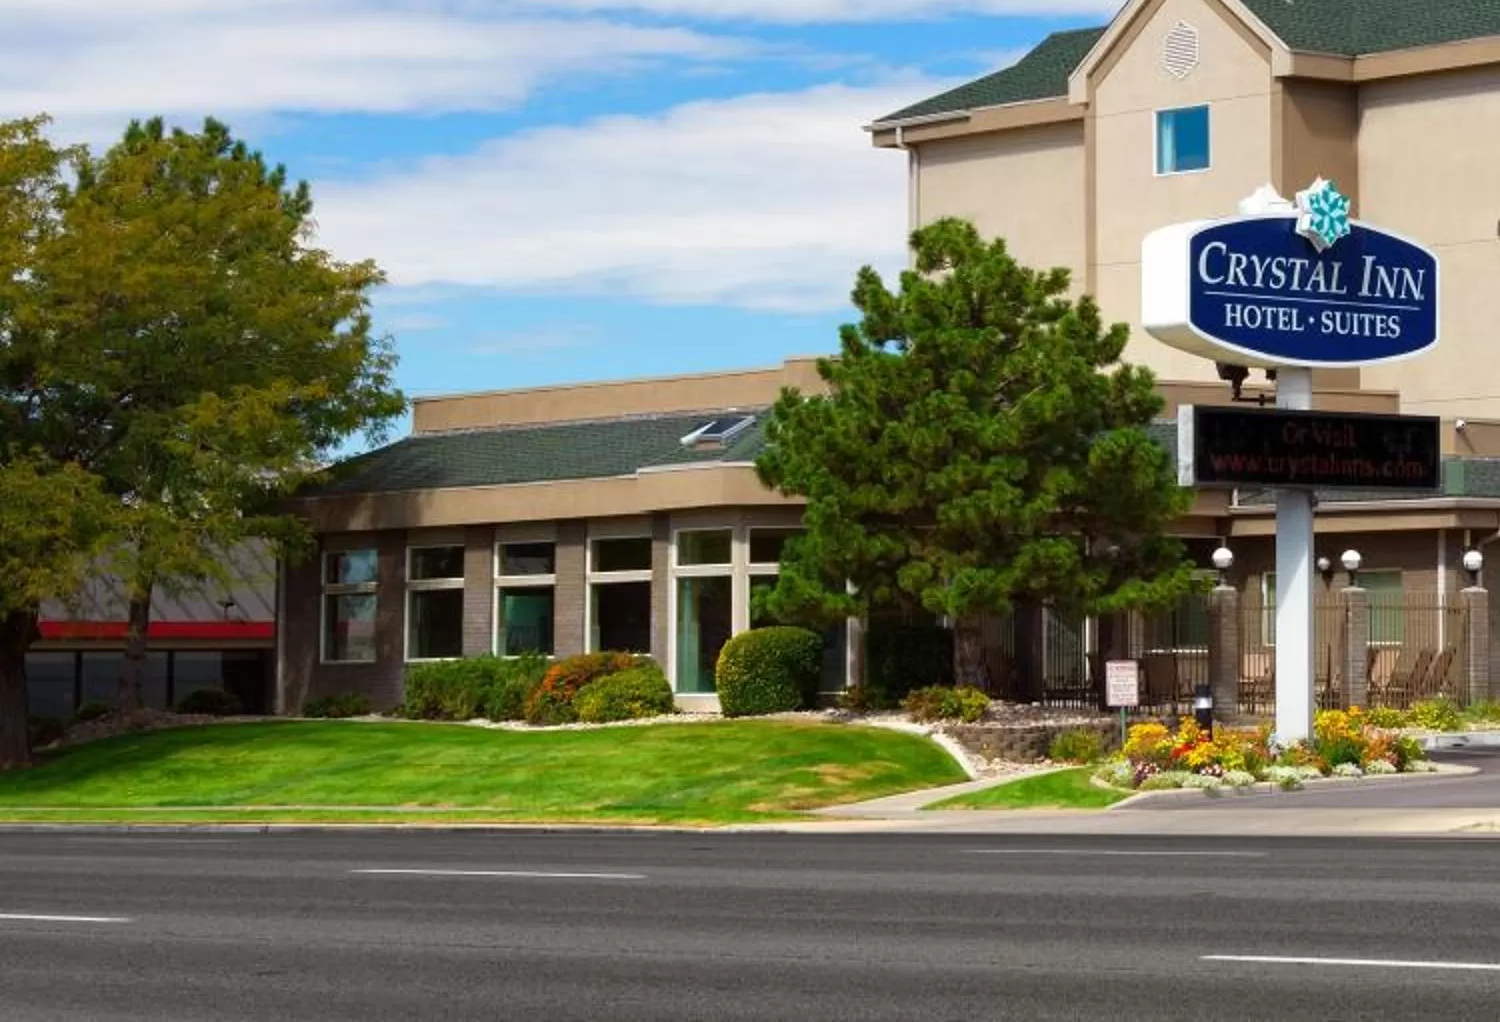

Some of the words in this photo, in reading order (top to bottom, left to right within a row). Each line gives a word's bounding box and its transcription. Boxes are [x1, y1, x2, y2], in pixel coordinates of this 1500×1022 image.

[1198, 241, 1347, 294] CRYSTAL
[1357, 254, 1425, 301] INN
[1224, 303, 1305, 331] HOTEL
[1320, 310, 1401, 339] SUITES
